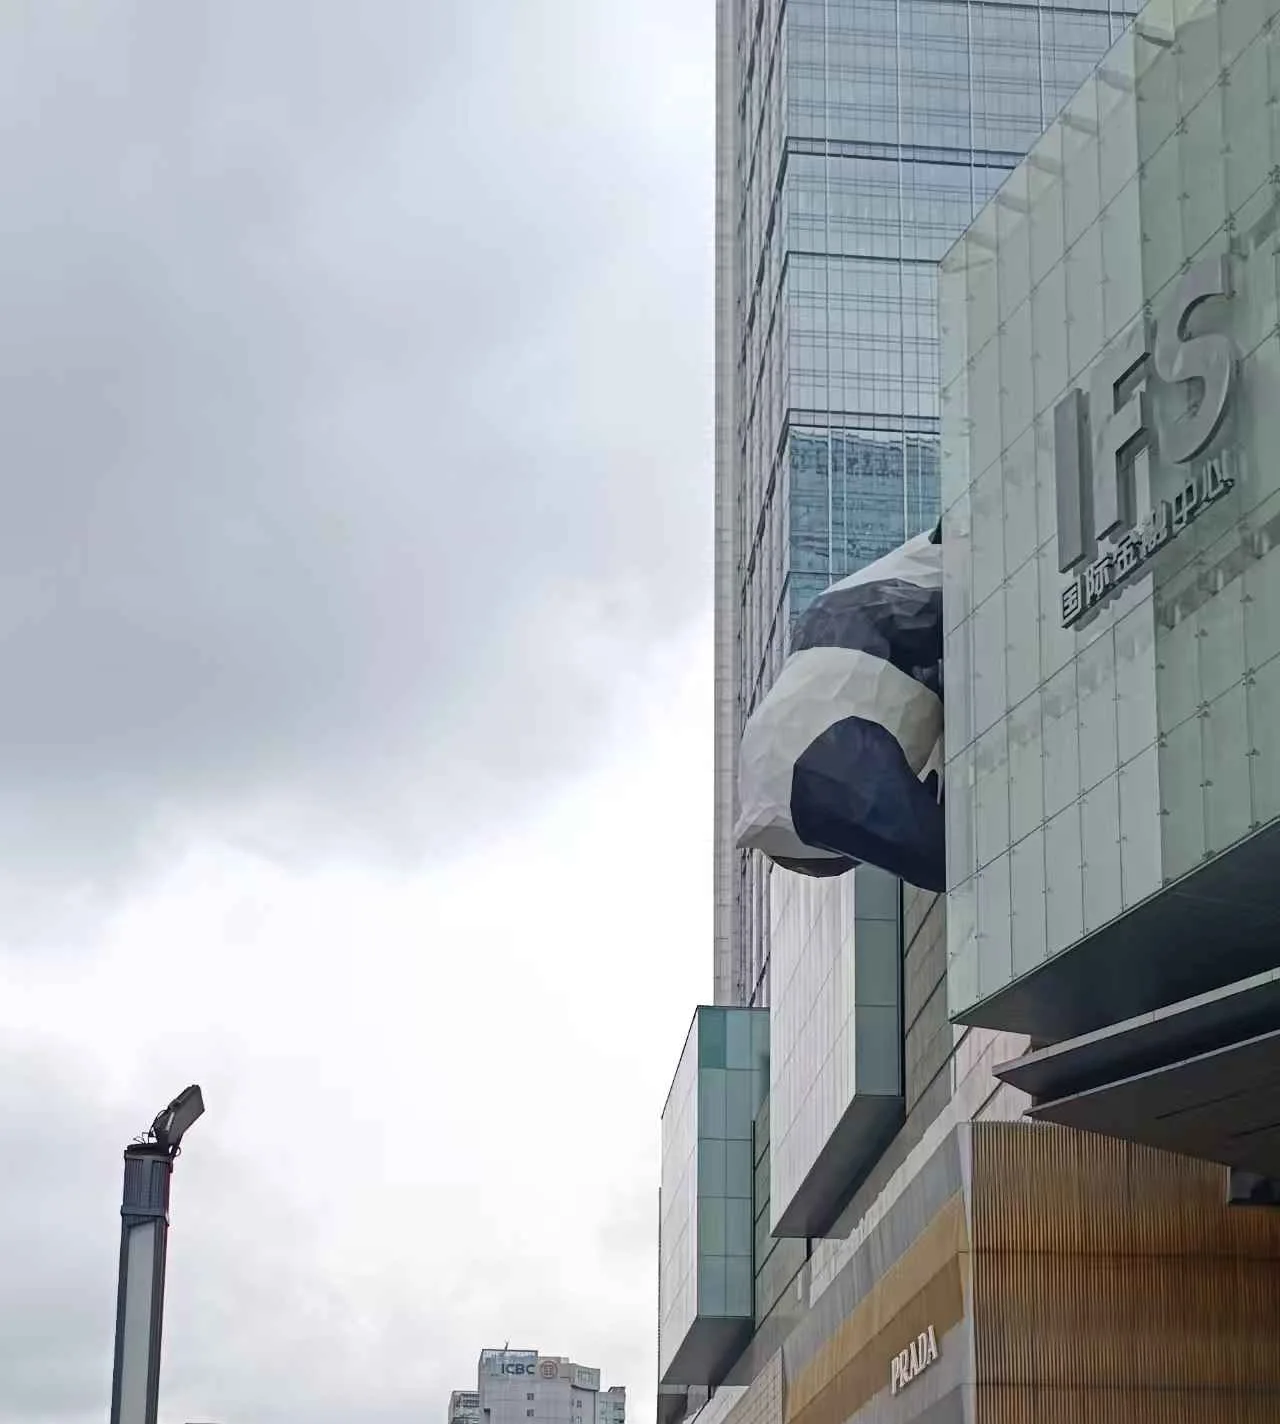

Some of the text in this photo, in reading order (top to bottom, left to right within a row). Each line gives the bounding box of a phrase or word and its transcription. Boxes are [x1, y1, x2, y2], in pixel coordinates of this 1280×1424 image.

[1053, 253, 1235, 575] IFS
[1061, 450, 1236, 628] 国际金融中心
[501, 1363, 536, 1375] ICBC
[891, 1324, 939, 1395] PRADA
